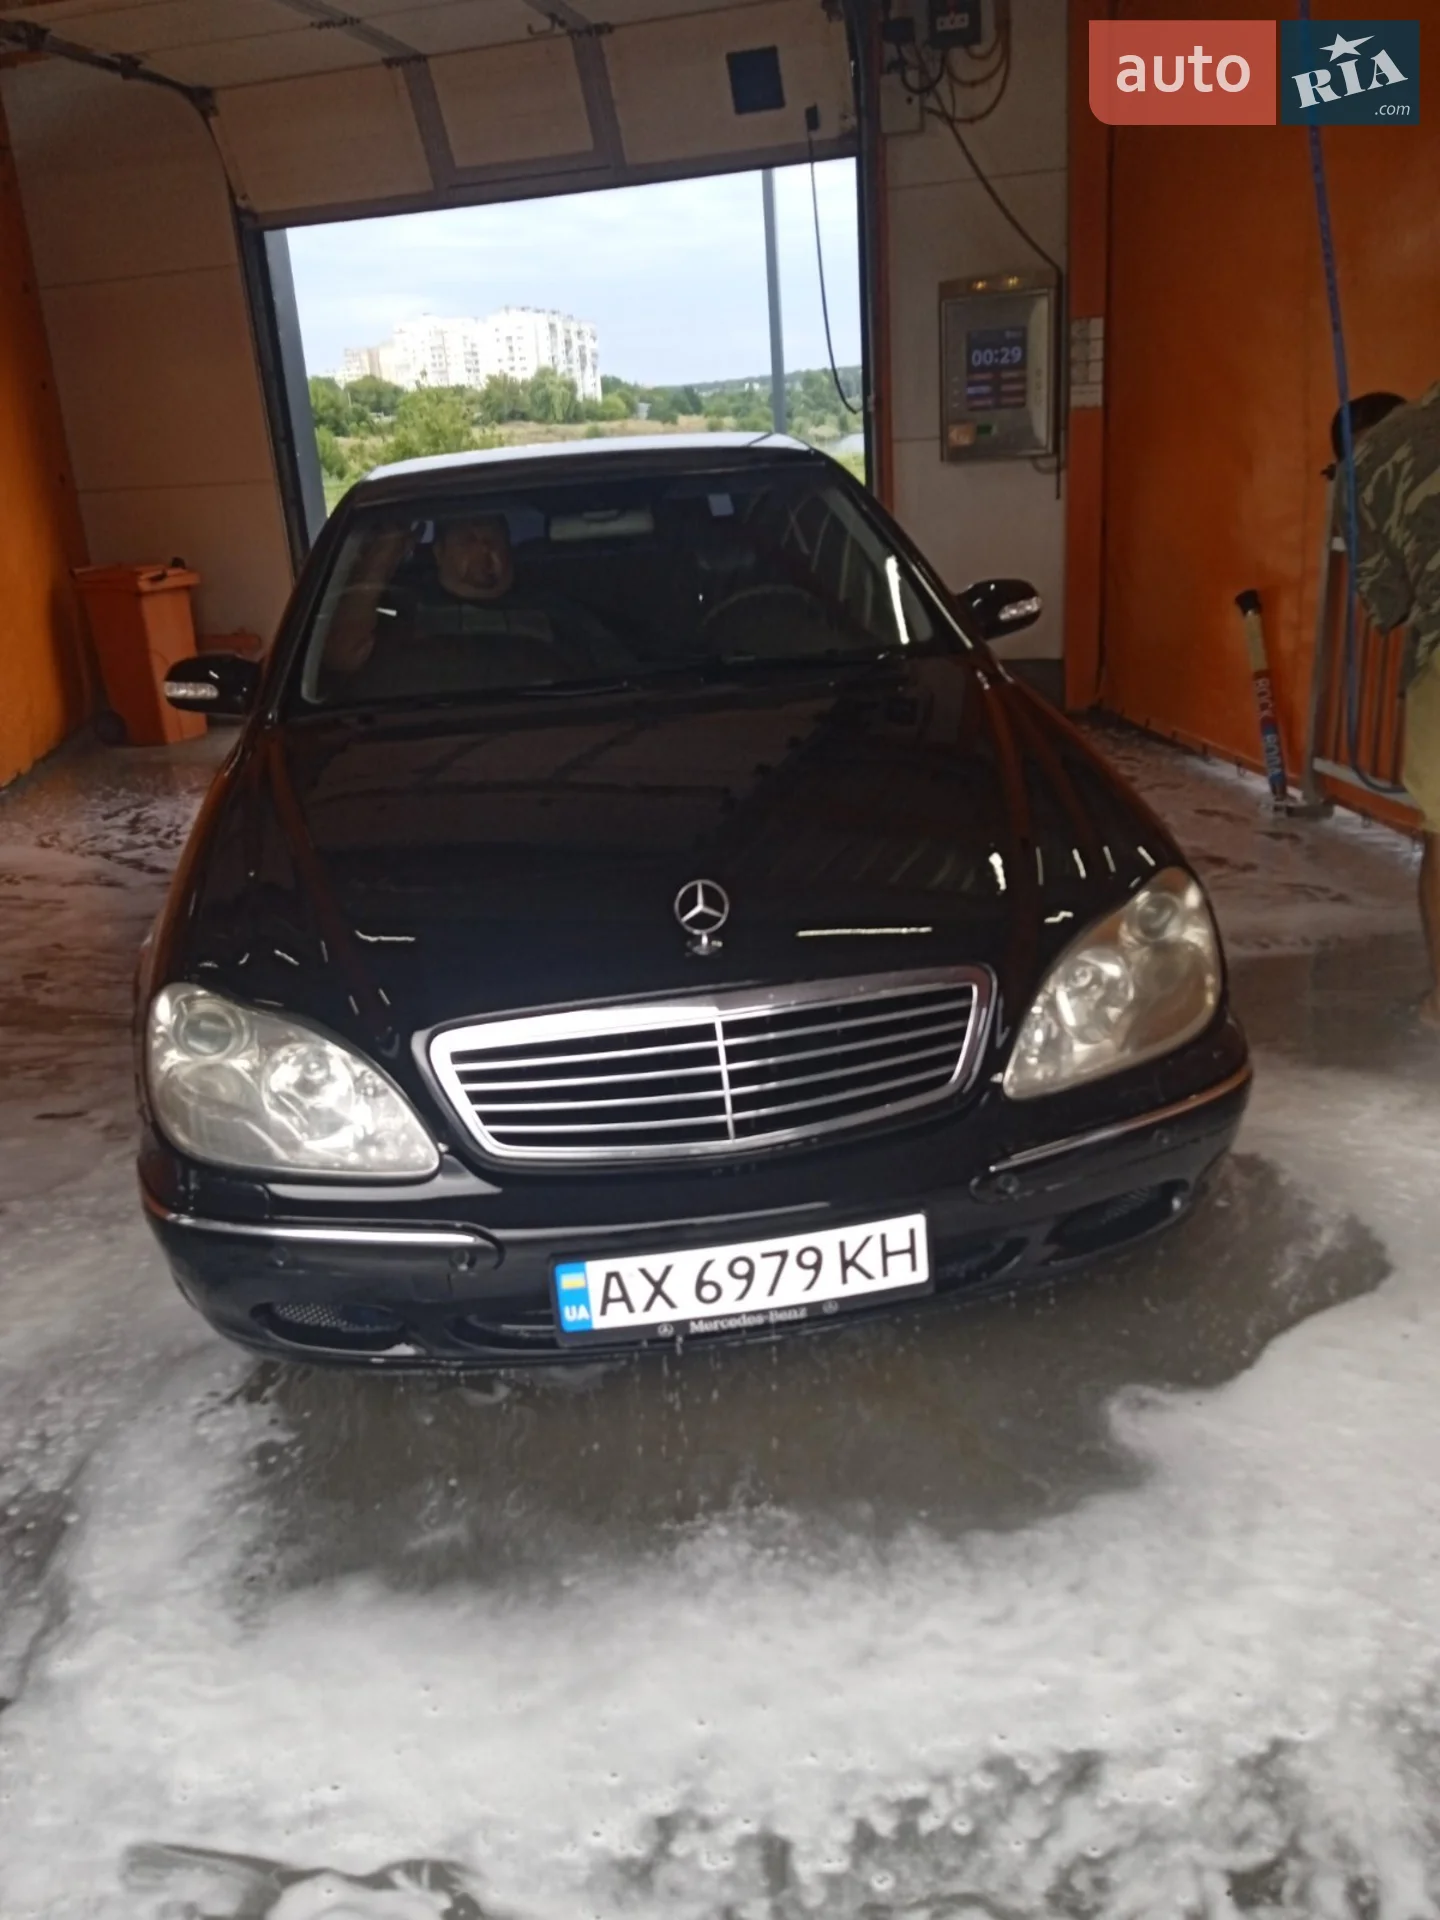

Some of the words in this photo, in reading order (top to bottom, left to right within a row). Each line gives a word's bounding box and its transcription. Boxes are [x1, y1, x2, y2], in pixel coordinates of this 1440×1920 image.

[971, 346, 1023, 367] 00:29
[564, 1305, 590, 1322] UA
[600, 1264, 678, 1316] AX
[695, 1246, 823, 1304] 6979
[838, 1228, 918, 1285] KH
